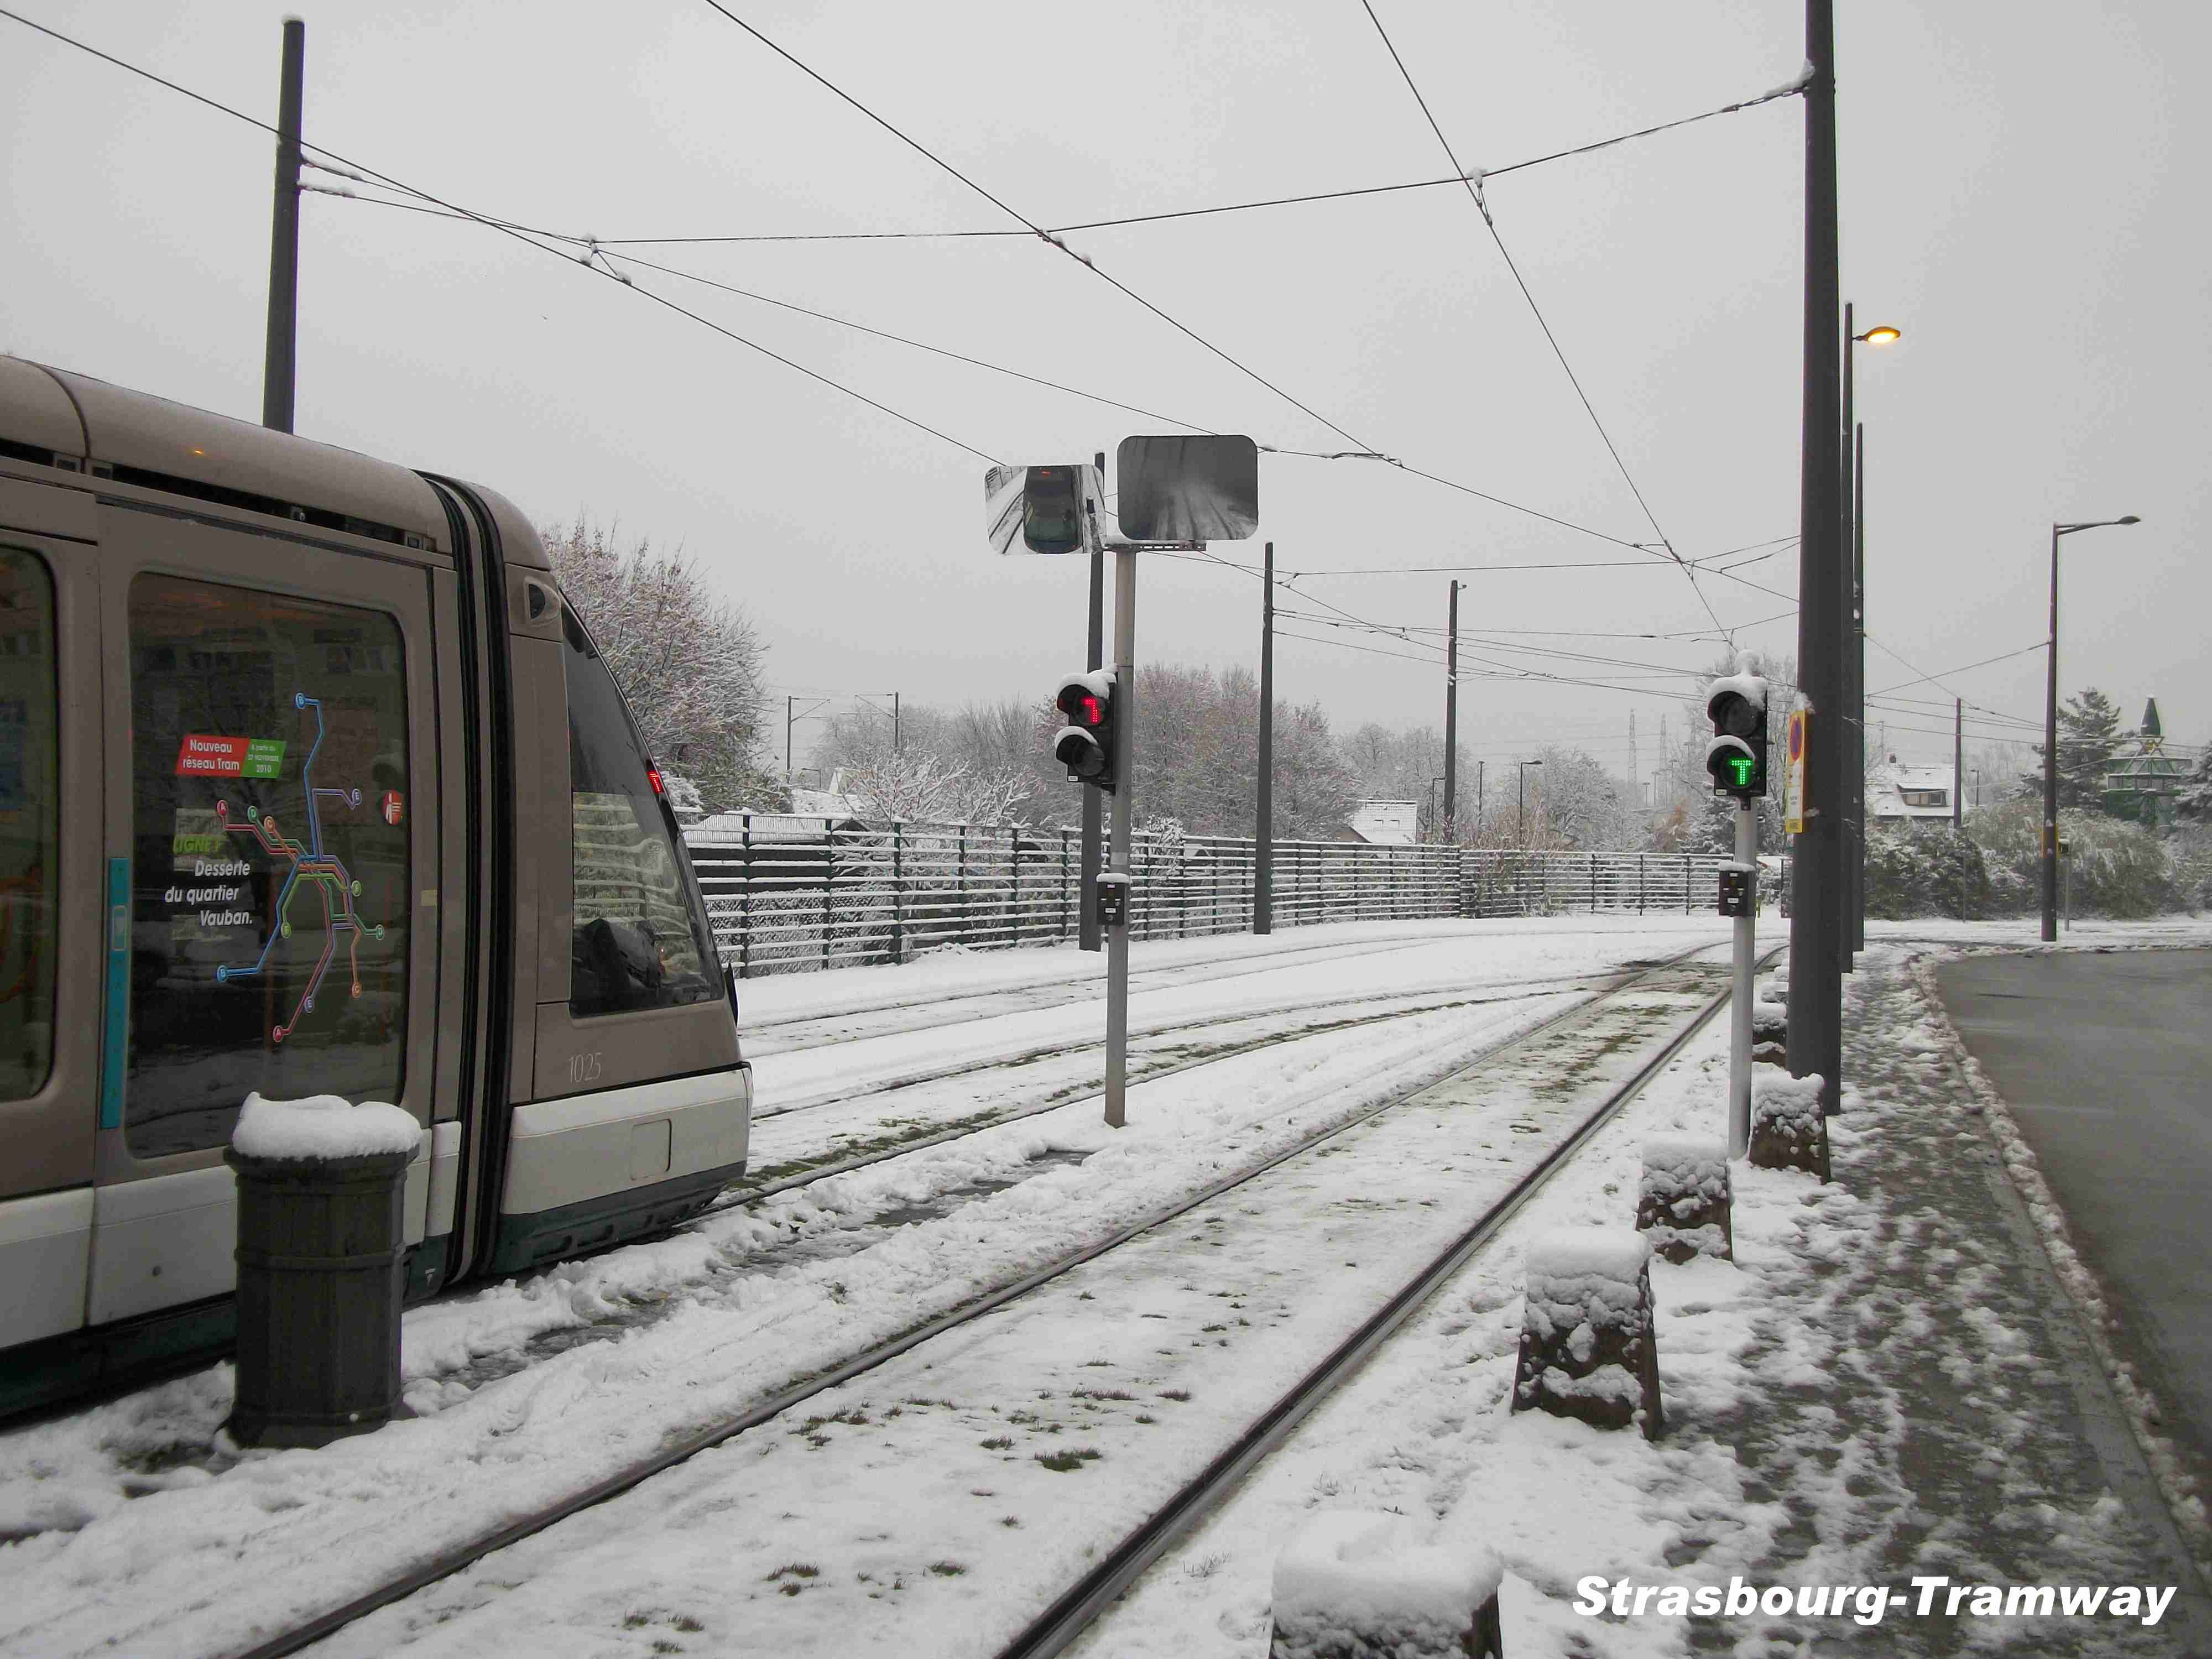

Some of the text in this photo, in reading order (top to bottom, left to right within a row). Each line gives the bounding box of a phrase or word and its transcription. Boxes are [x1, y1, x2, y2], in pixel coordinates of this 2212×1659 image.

[190, 739, 232, 753] Nouveau
[183, 755, 215, 769] réseau
[216, 758, 239, 770] Tram
[1731, 759, 1752, 785] T
[195, 859, 250, 877] Desserte
[164, 885, 239, 905] du quartier
[200, 909, 253, 926] Vauban.
[566, 1052, 602, 1083] 1025
